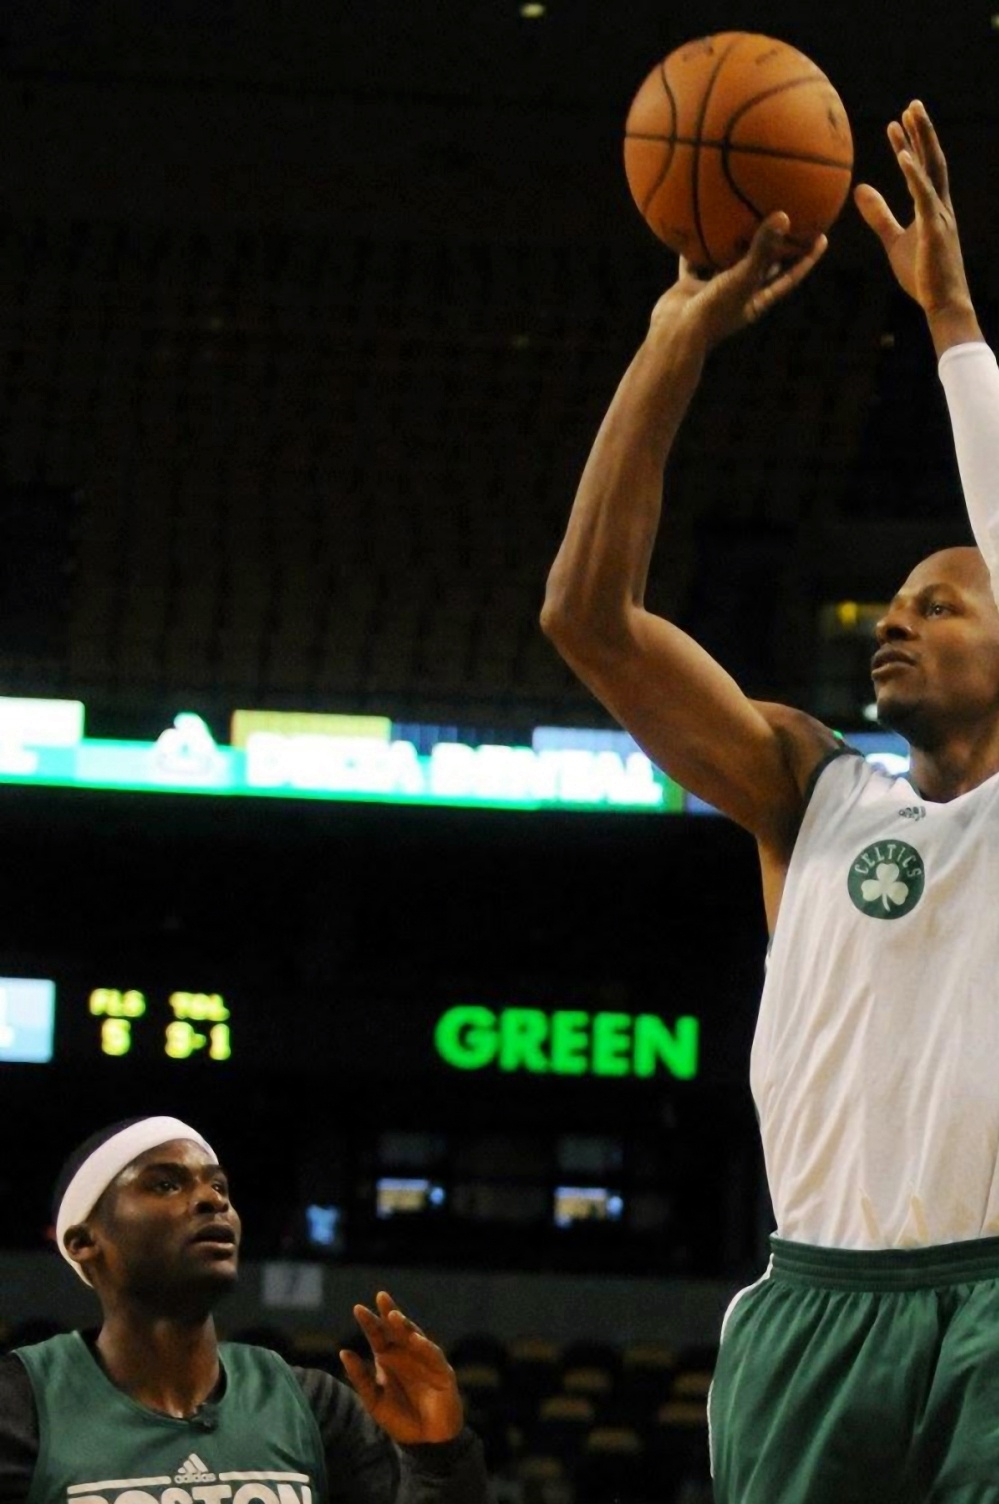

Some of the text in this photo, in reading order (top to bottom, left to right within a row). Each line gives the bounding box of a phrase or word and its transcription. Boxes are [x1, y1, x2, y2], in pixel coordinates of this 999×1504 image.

[854, 843, 922, 877] CELTICS
[433, 1005, 699, 1080] GREEN
[174, 1472, 216, 1484] adidas
